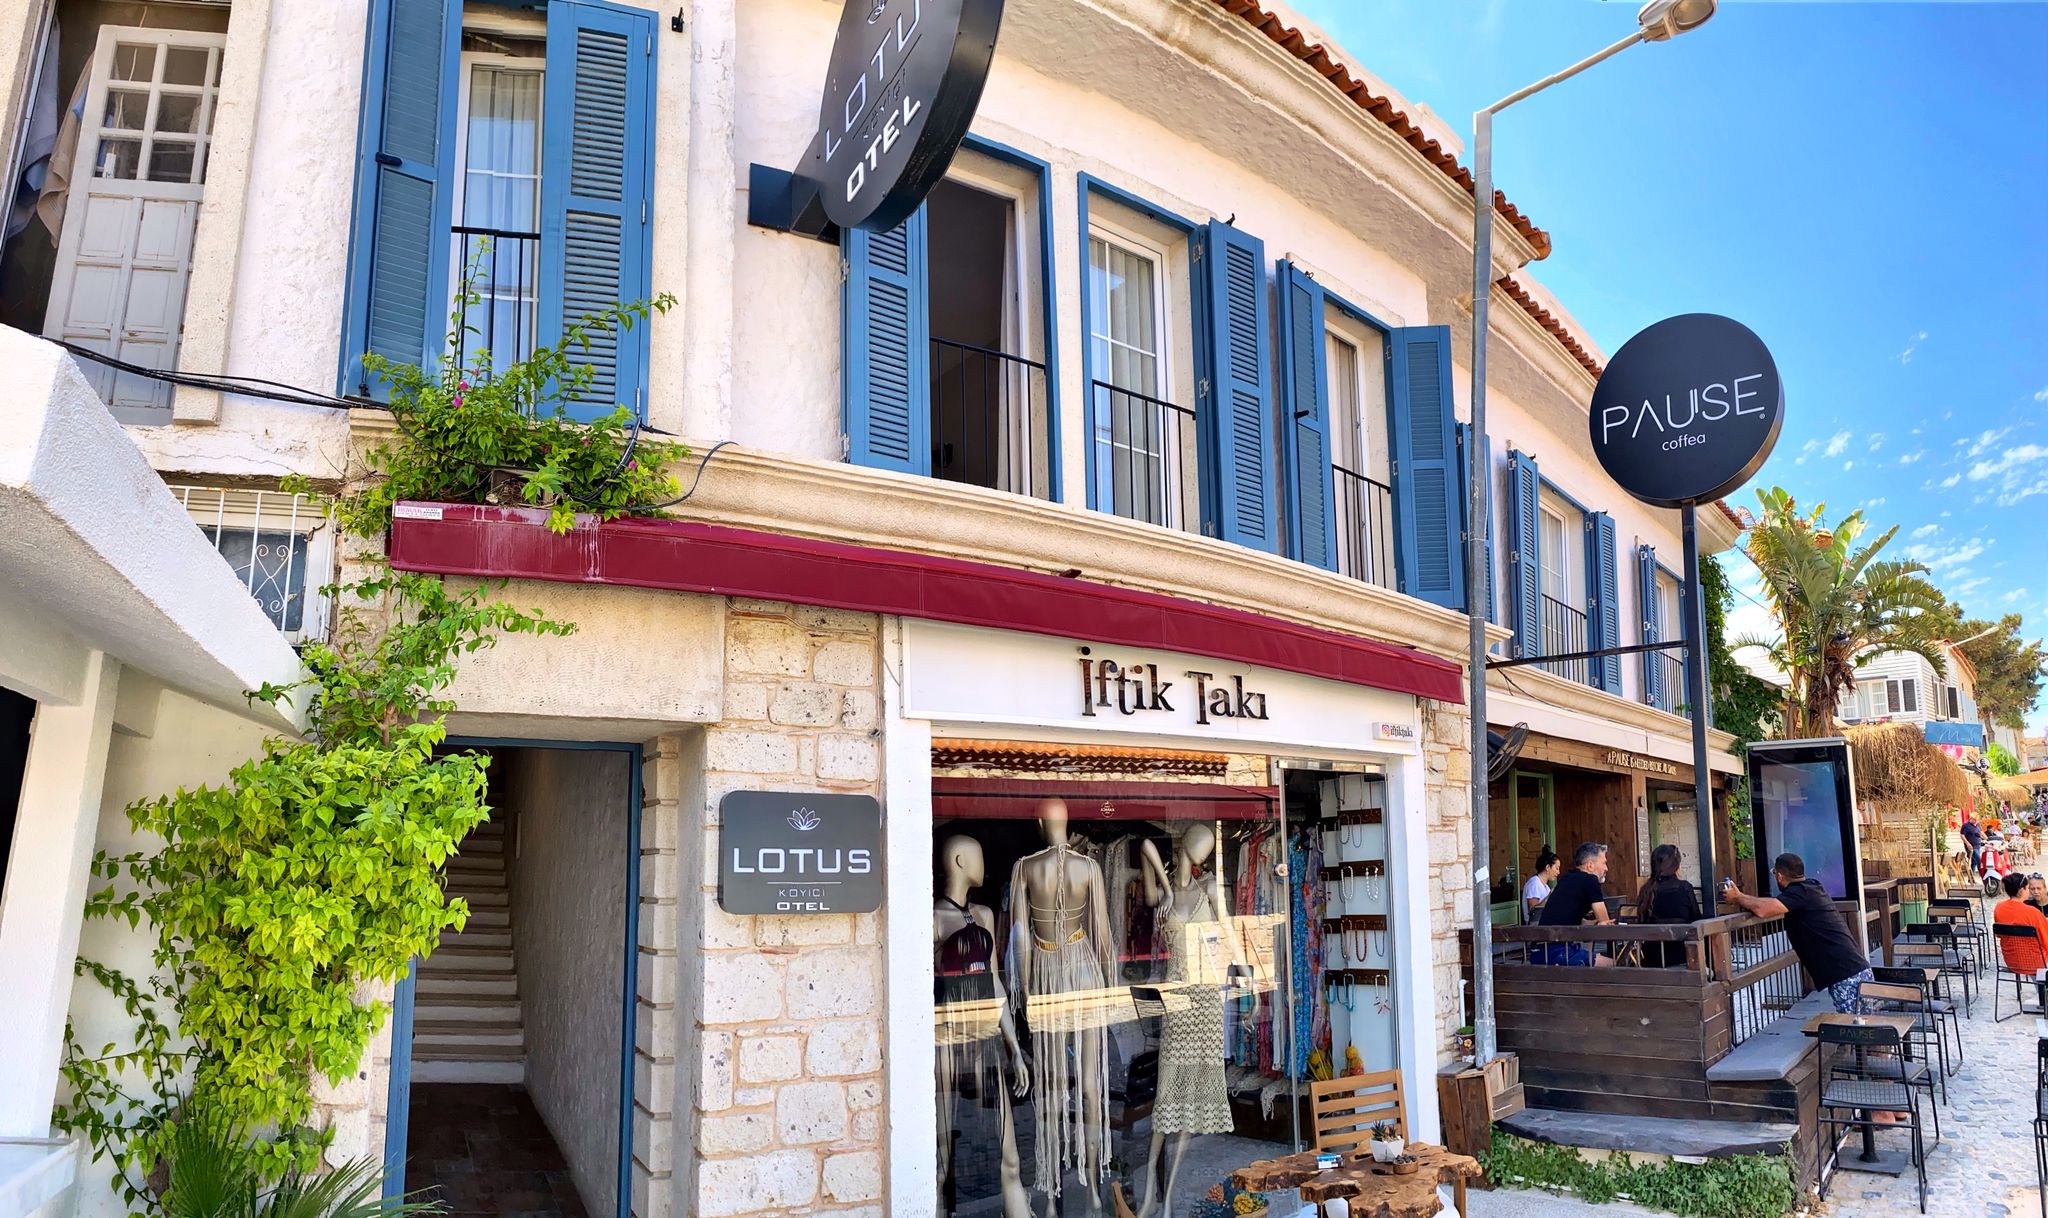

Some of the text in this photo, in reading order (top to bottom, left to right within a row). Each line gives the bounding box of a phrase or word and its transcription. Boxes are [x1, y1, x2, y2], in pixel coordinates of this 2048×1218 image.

[825, 0, 934, 163] LOTU
[847, 96, 921, 202] OTEL
[1602, 373, 1765, 444] PAUSE
[1662, 433, 1706, 451] coffea
[1078, 646, 1269, 725] İftik Takı
[1612, 750, 1630, 767] PAUSE
[733, 847, 871, 874] LOTUS
[776, 902, 830, 911] OTEL
[1839, 1027, 1876, 1039] PAUSE
